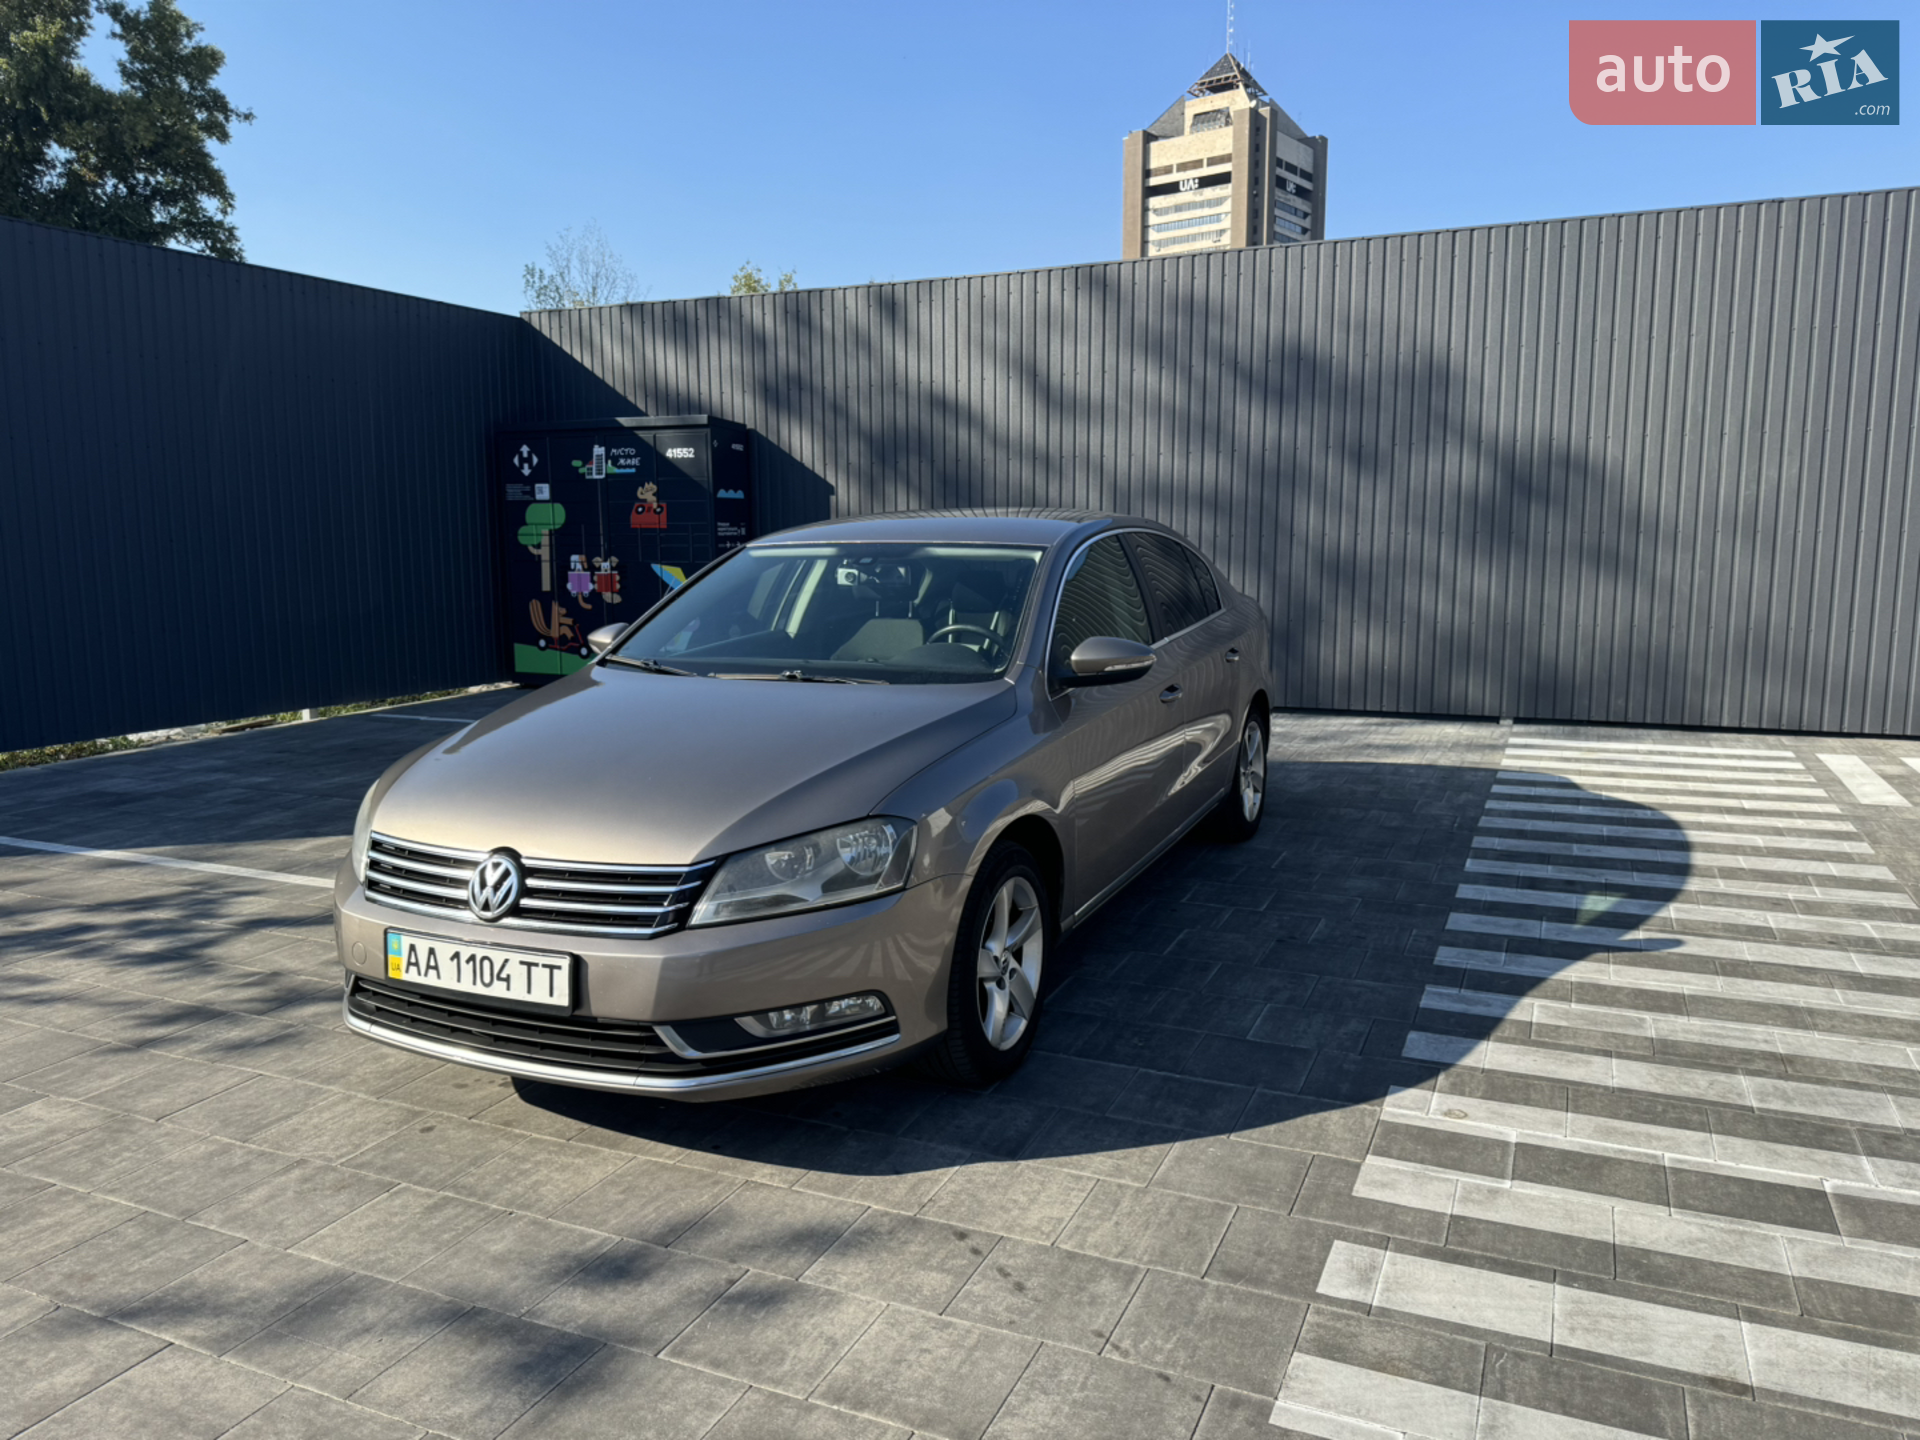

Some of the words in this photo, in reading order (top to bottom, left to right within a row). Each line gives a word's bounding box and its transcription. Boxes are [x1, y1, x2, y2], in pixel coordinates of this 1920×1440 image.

[665, 447, 695, 458] 41552
[390, 961, 402, 973] UA
[404, 943, 441, 980] AA
[449, 950, 511, 992] 1104
[518, 959, 562, 998] TT
